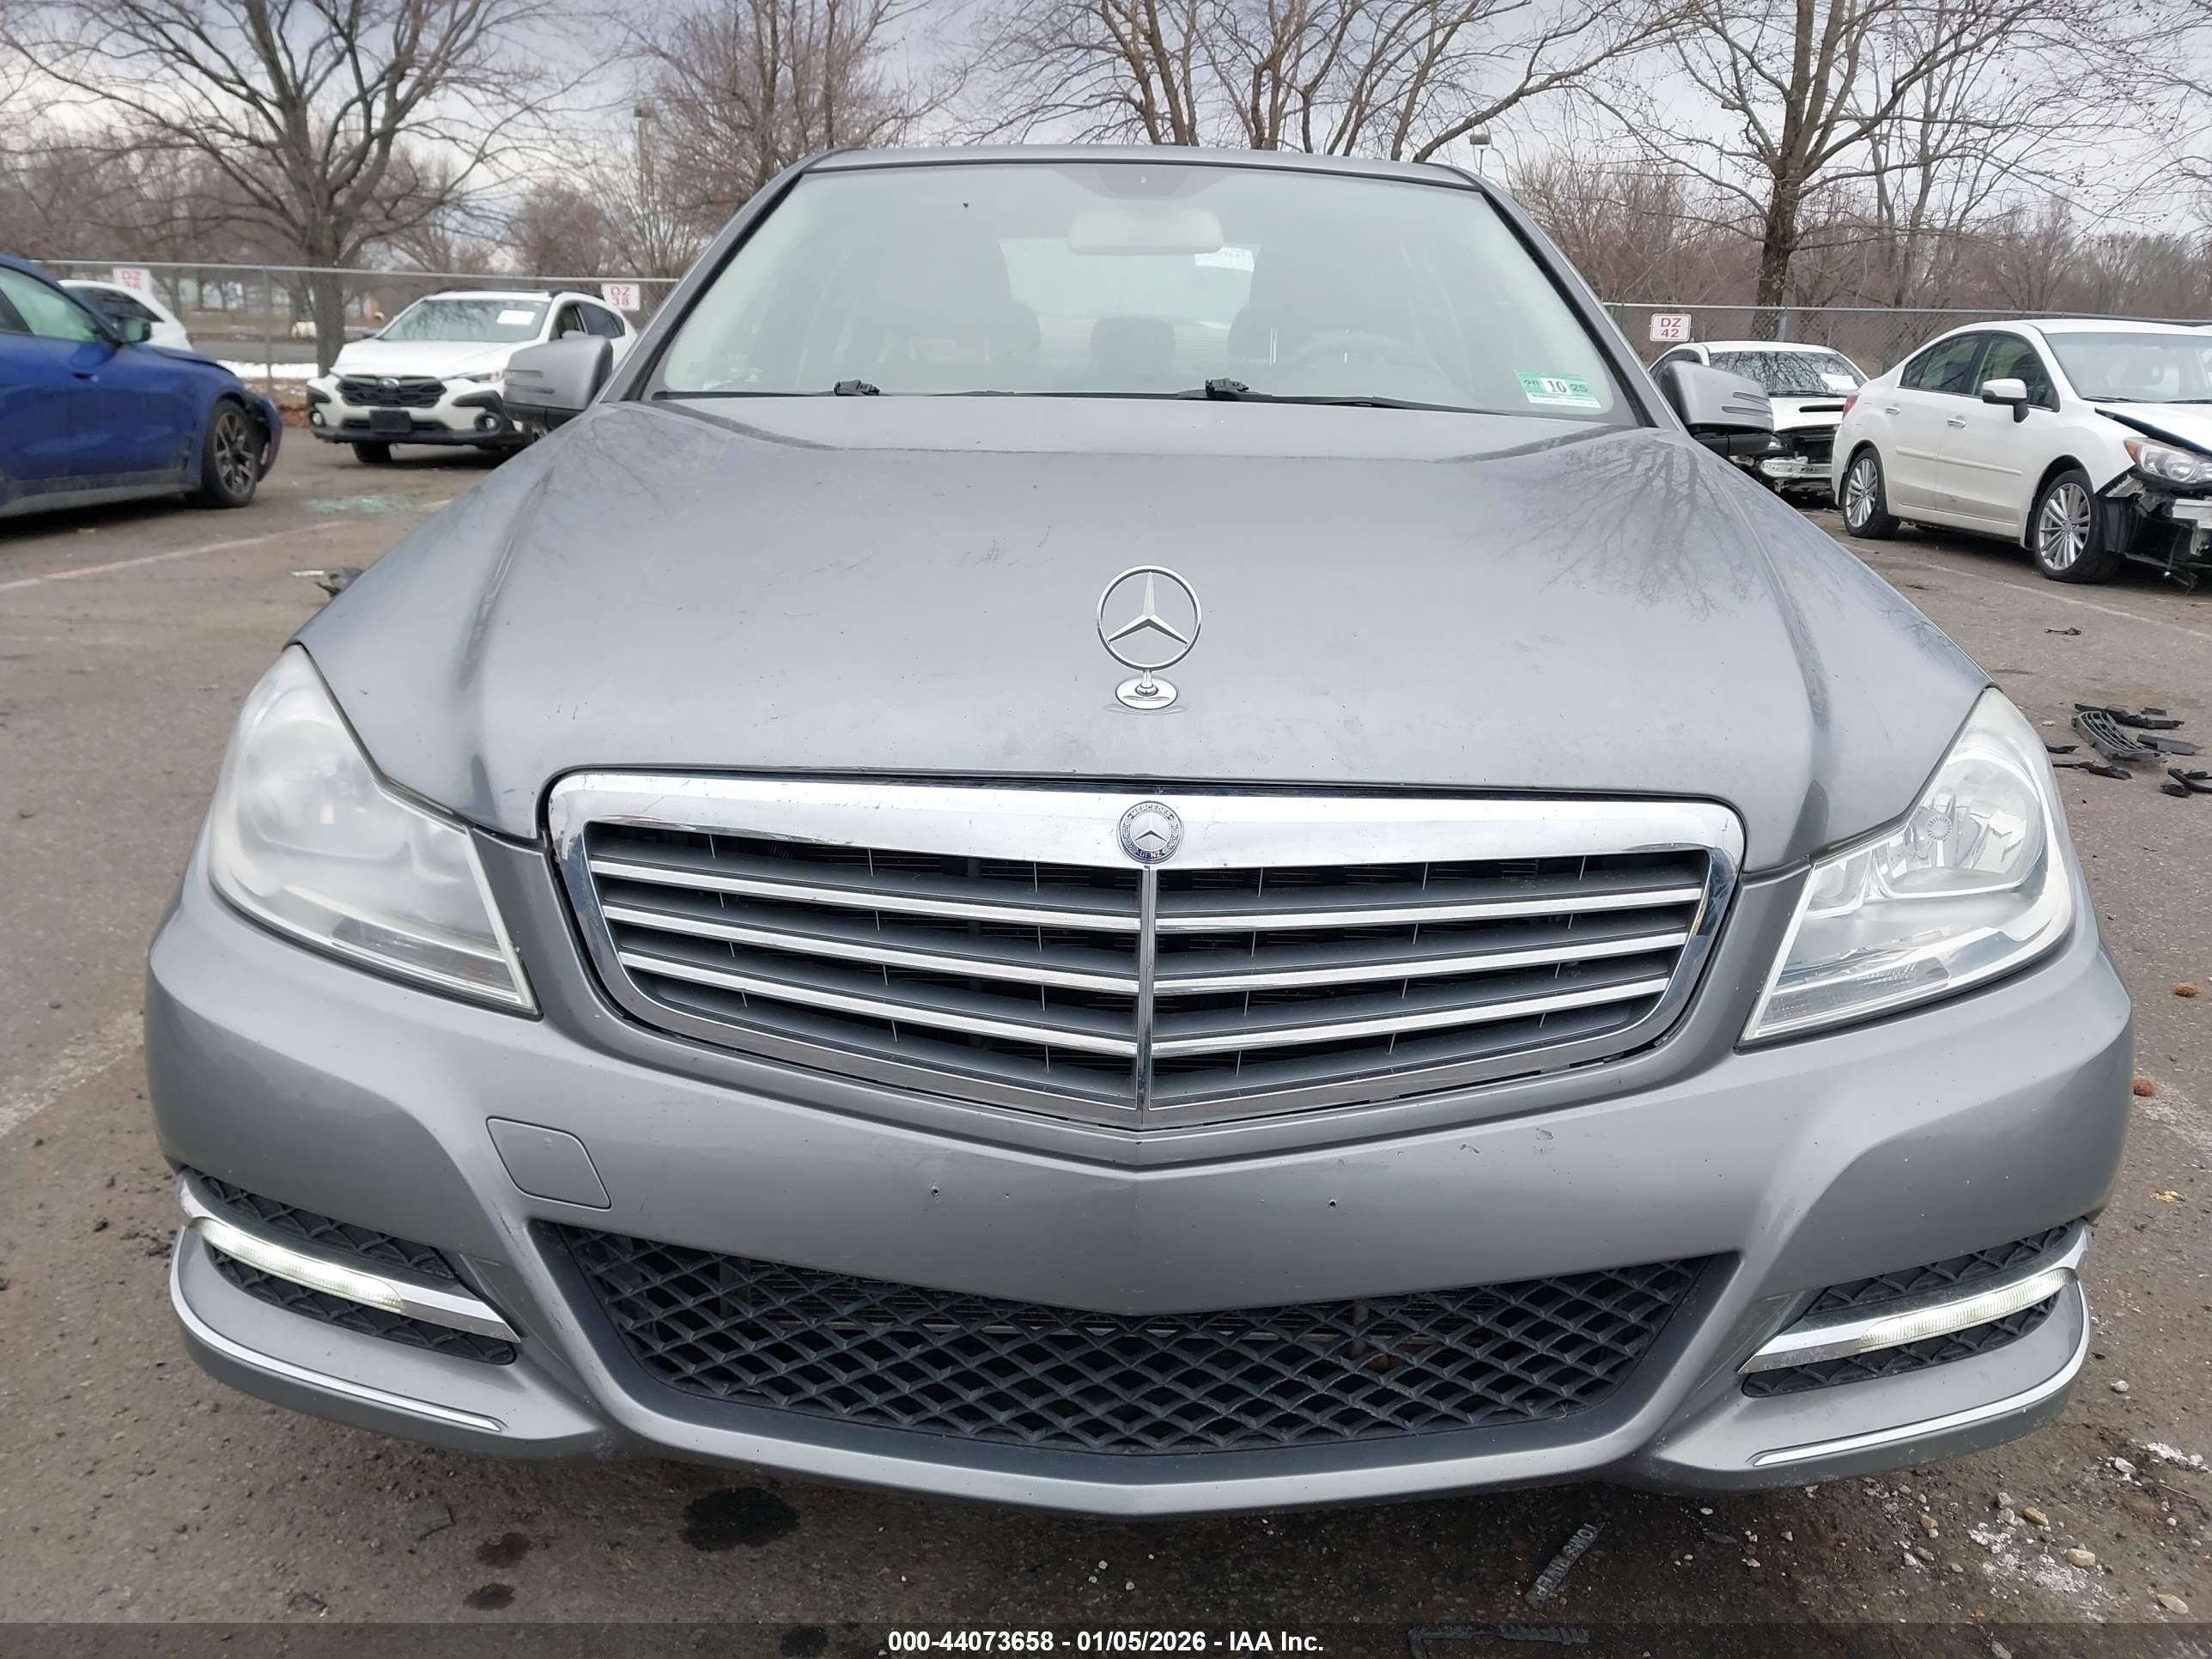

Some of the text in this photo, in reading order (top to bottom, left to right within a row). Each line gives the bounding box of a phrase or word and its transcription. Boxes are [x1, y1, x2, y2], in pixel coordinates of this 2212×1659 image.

[611, 286, 630, 295] DZ
[1661, 318, 1682, 327] DZ
[1661, 329, 1680, 338] 42
[1547, 380, 1567, 393] 10
[1129, 804, 1171, 817] MERCEDES
